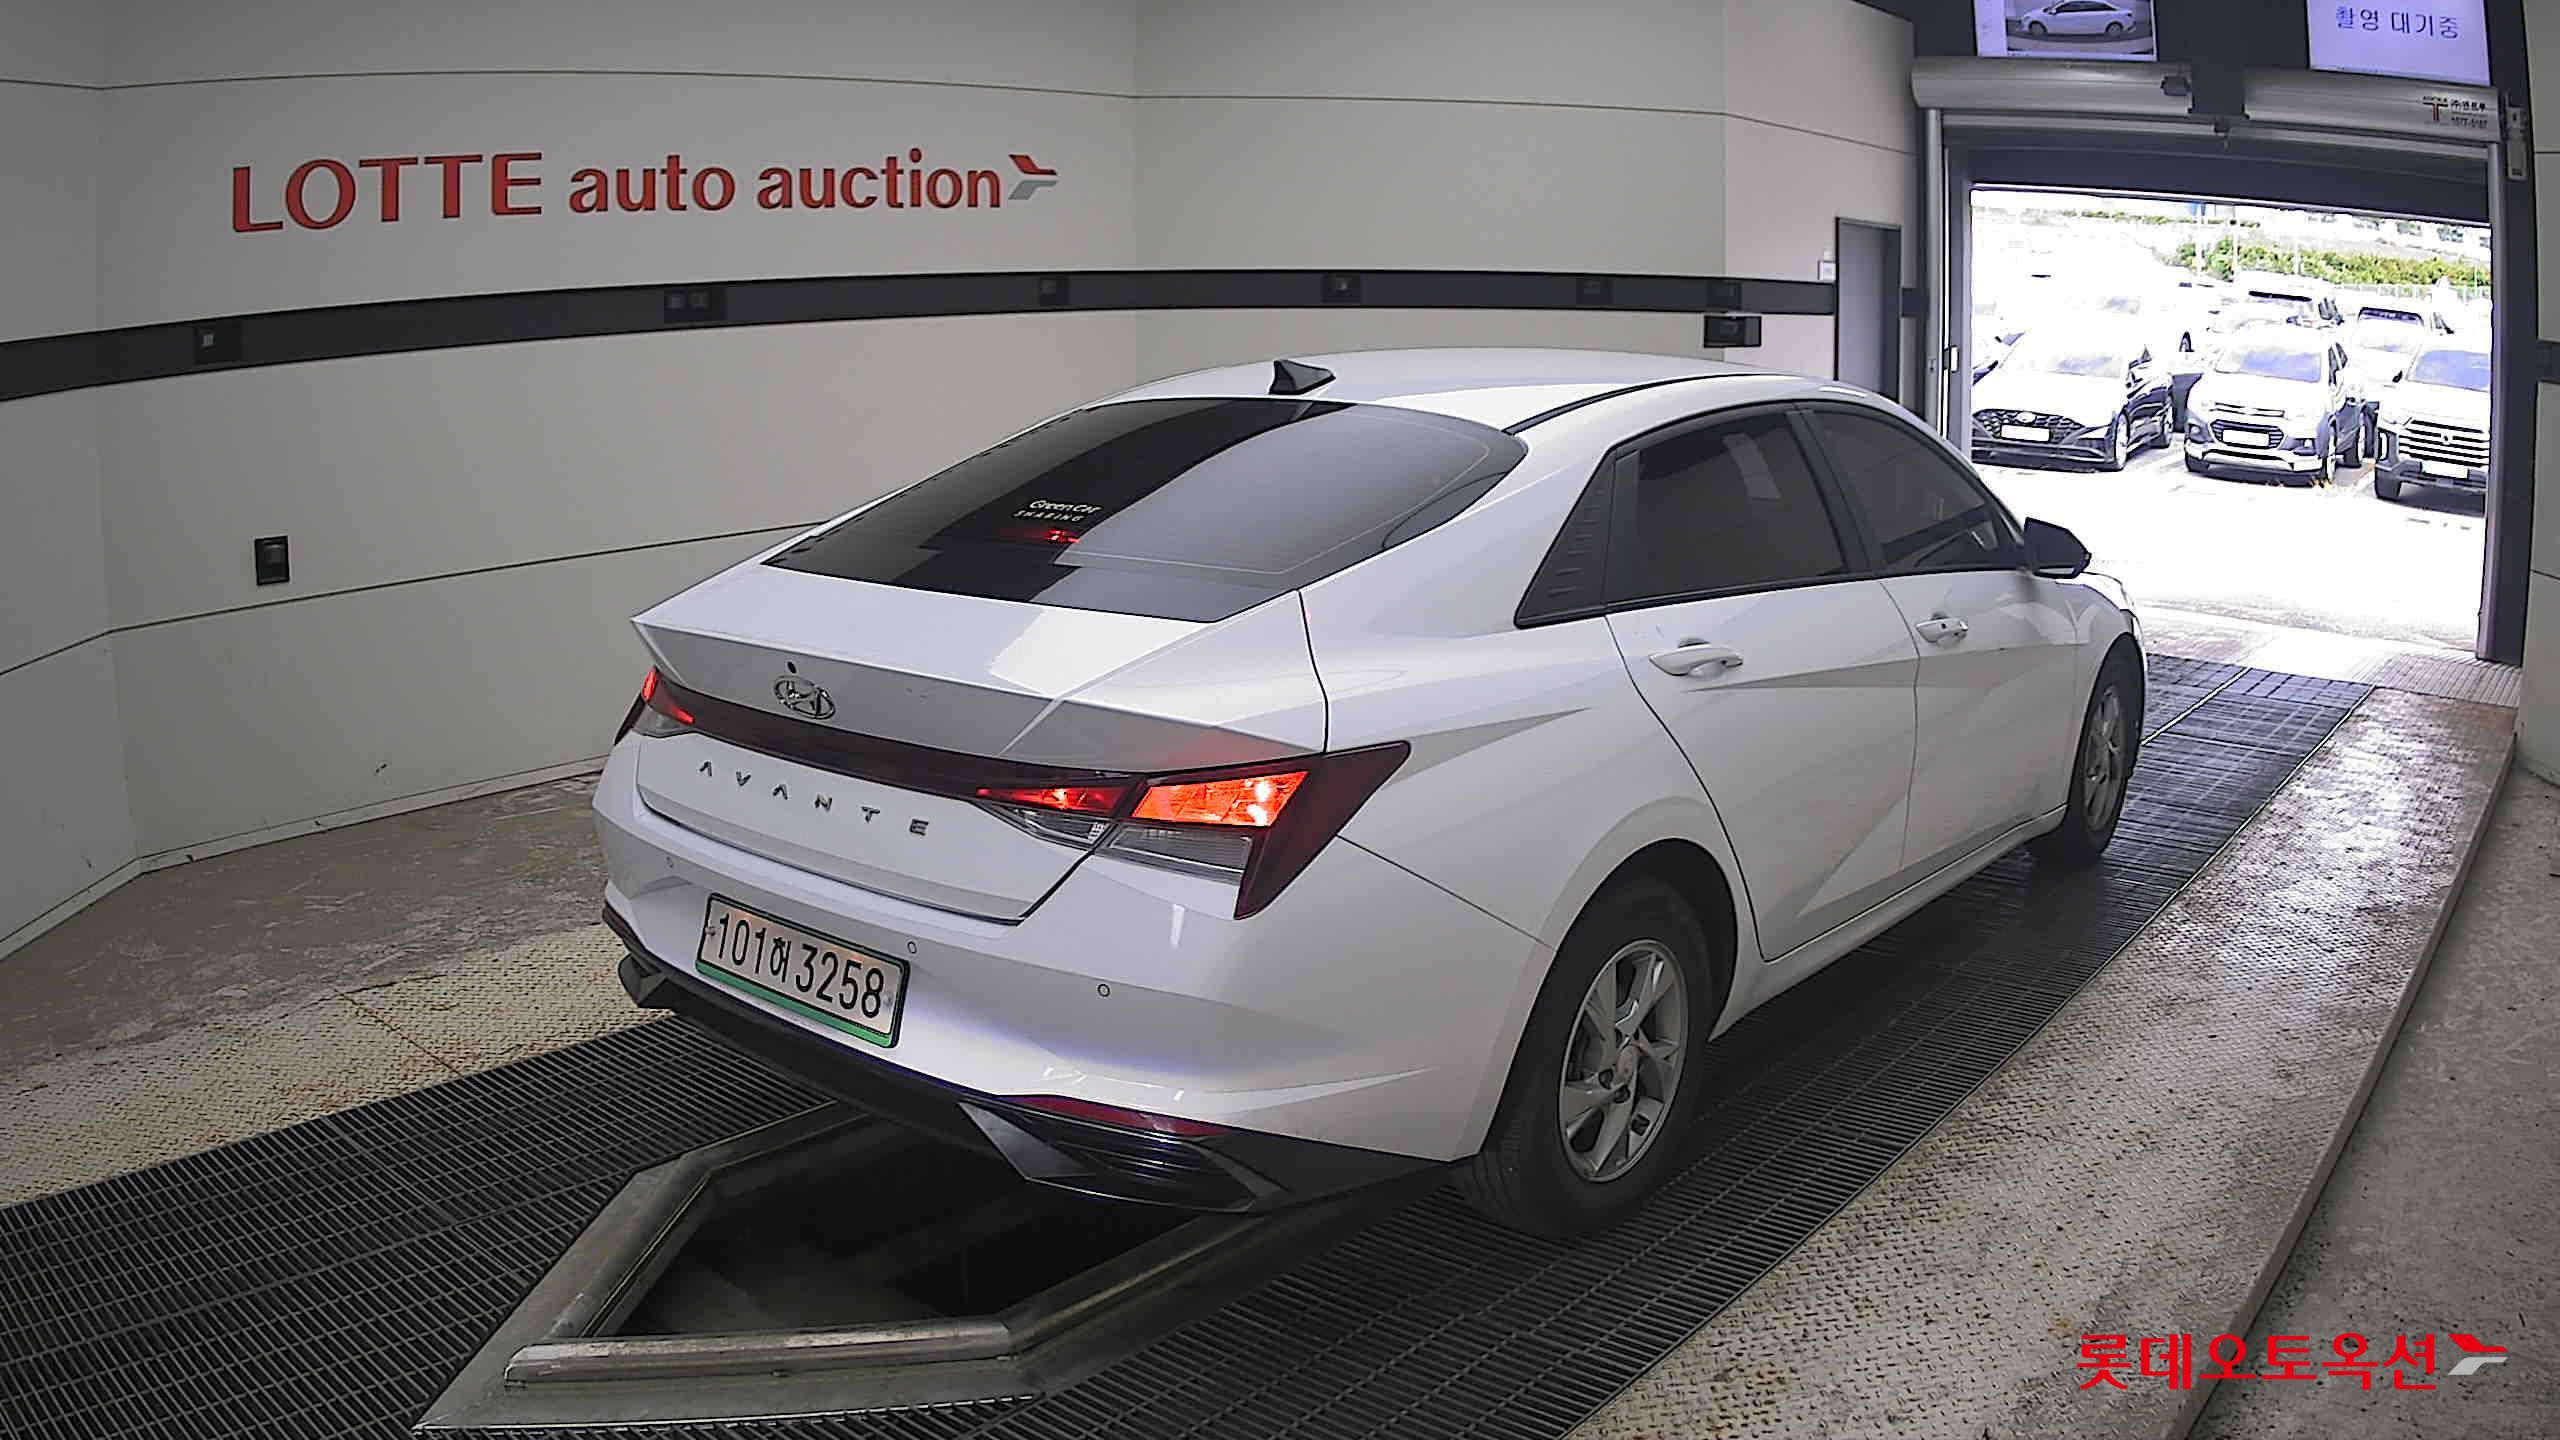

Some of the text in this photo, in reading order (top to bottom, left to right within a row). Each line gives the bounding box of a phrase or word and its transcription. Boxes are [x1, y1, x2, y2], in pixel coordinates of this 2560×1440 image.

[2391, 12, 2459, 39] 대기중
[232, 147, 1003, 233] LOTTE auto auction
[1013, 510, 1084, 522] SHARING
[699, 760, 929, 836] AVANTE
